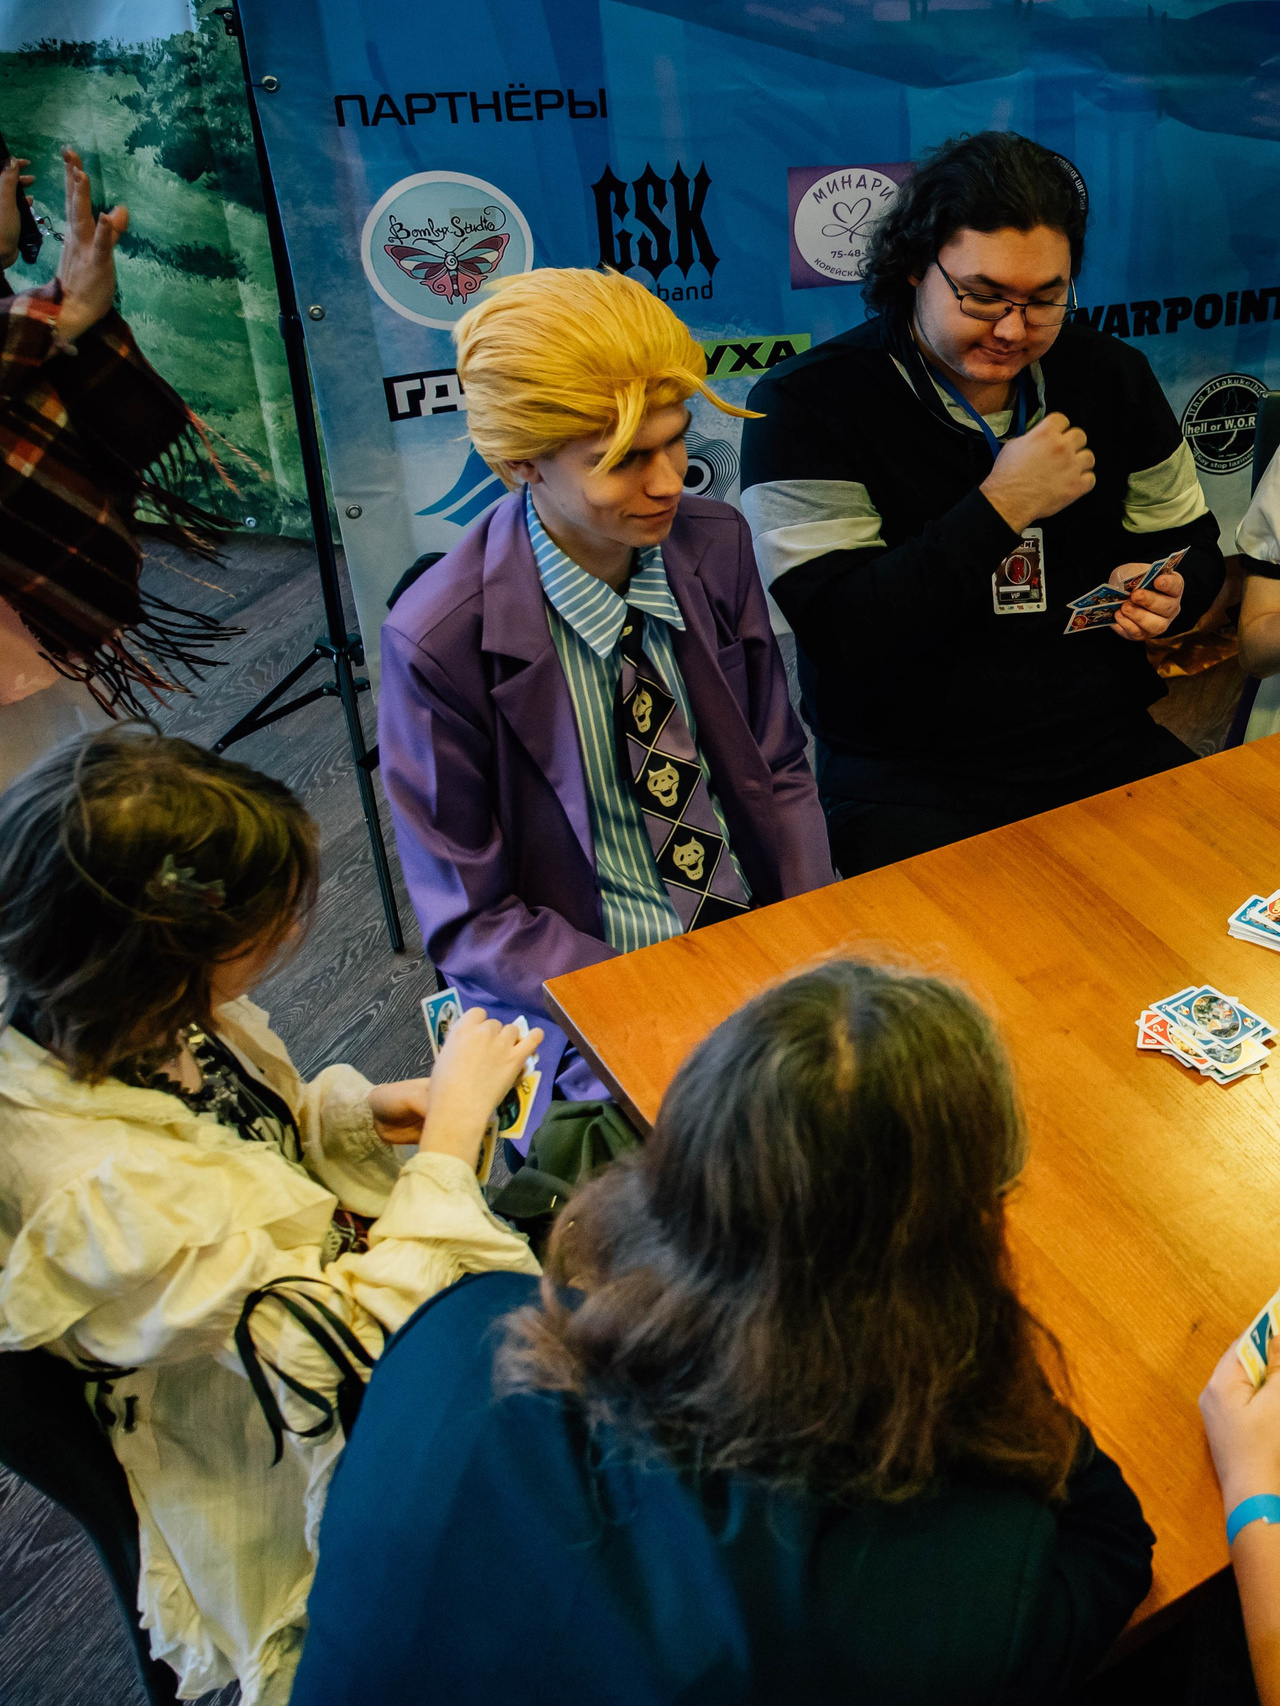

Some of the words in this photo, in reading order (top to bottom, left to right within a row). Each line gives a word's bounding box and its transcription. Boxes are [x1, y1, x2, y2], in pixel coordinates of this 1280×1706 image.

[334, 83, 608, 127] ПАРТНЁРЫ
[812, 174, 895, 204] МИНАРИ
[388, 214, 451, 245] Bombyx
[451, 205, 507, 238] Studio
[830, 249, 866, 259] 75-48-
[704, 340, 797, 375] УХА
[1189, 395, 1205, 414] The
[1187, 422, 1207, 435] hell
[1210, 423, 1222, 432] or
[1210, 462, 1228, 470] stop
[428, 1004, 436, 1018] 5
